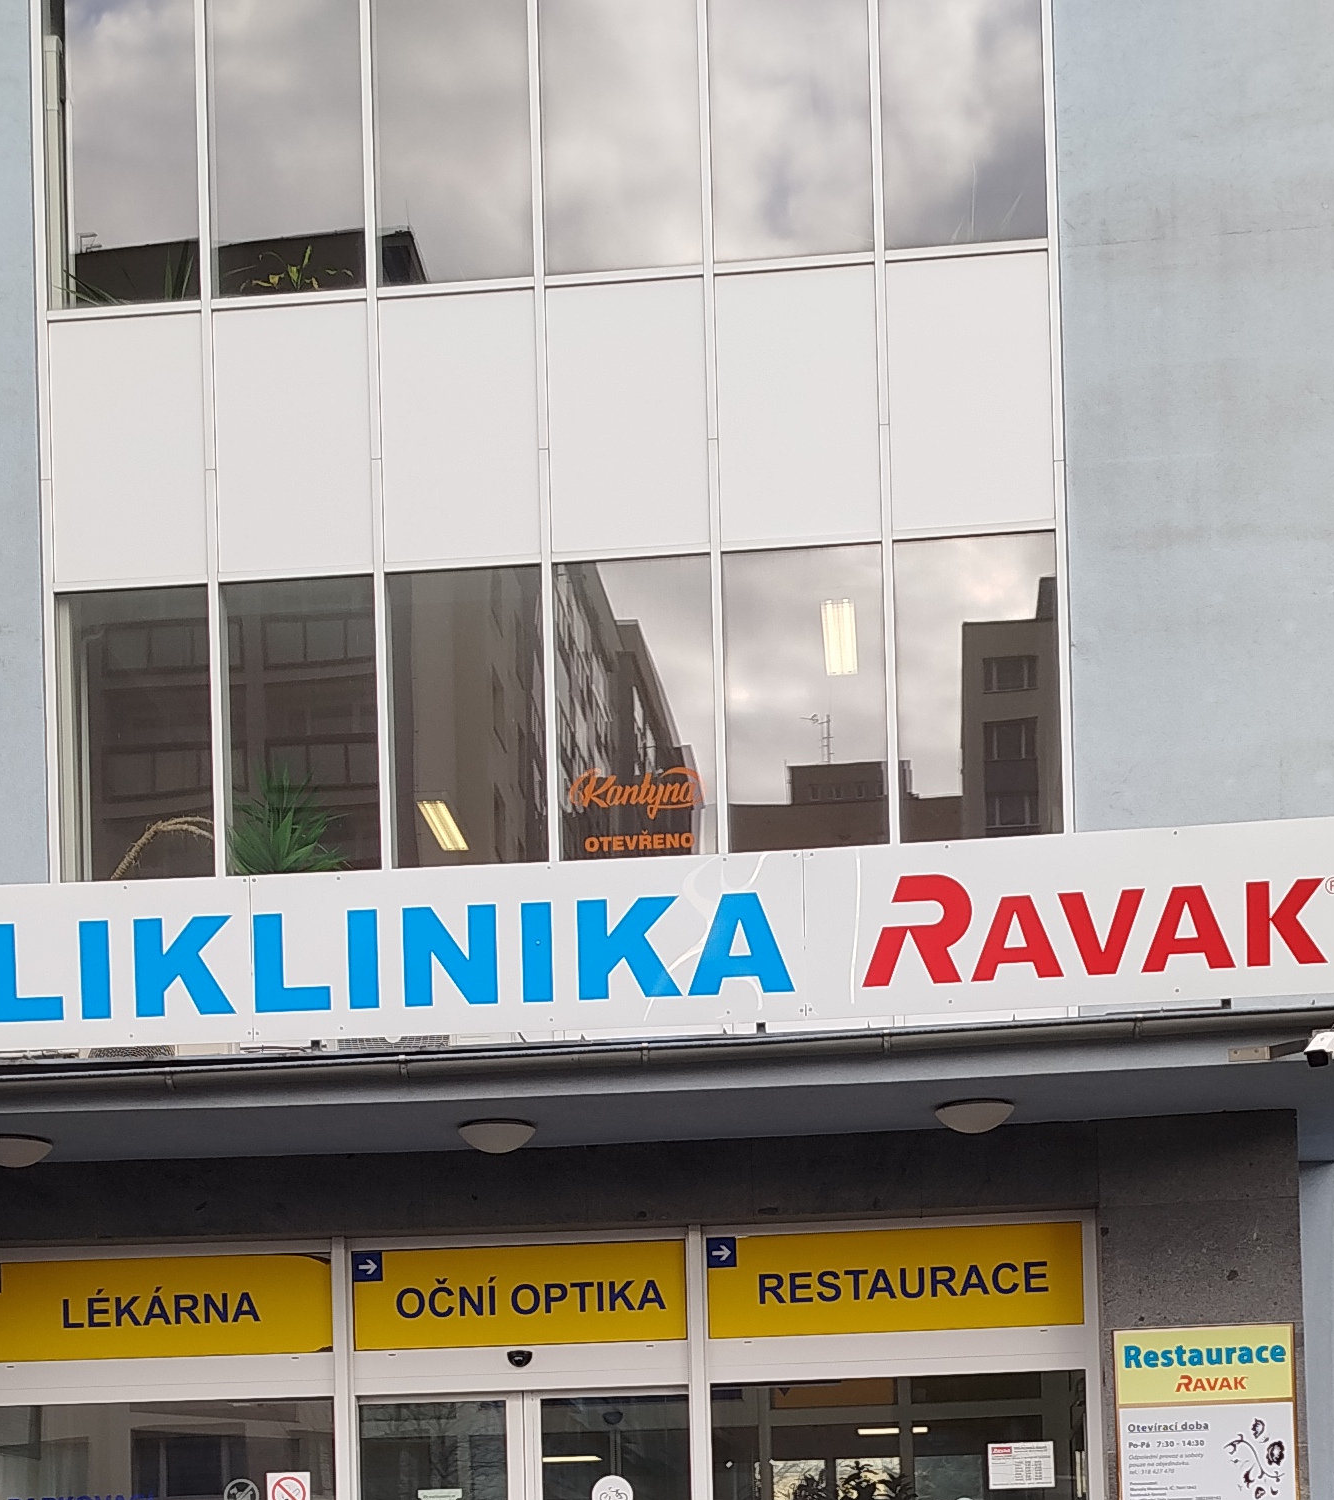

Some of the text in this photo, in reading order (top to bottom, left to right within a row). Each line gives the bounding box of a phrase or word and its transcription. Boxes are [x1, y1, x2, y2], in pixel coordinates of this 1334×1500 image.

[570, 766, 705, 820] Kantyna
[584, 829, 695, 853] OTEVŘENO
[862, 873, 1329, 988] RAVAK
[395, 1276, 667, 1319] OČNÍ OPTIKA
[758, 1261, 1050, 1304] RESTAURACE
[62, 1286, 262, 1329] LÉKÁRNA
[1124, 1345, 1286, 1369] Restaurace
[1175, 1375, 1248, 1393] RAVAK
[1128, 1421, 1209, 1432] Otevírací doba
[1156, 1440, 1174, 1448] 7:30
